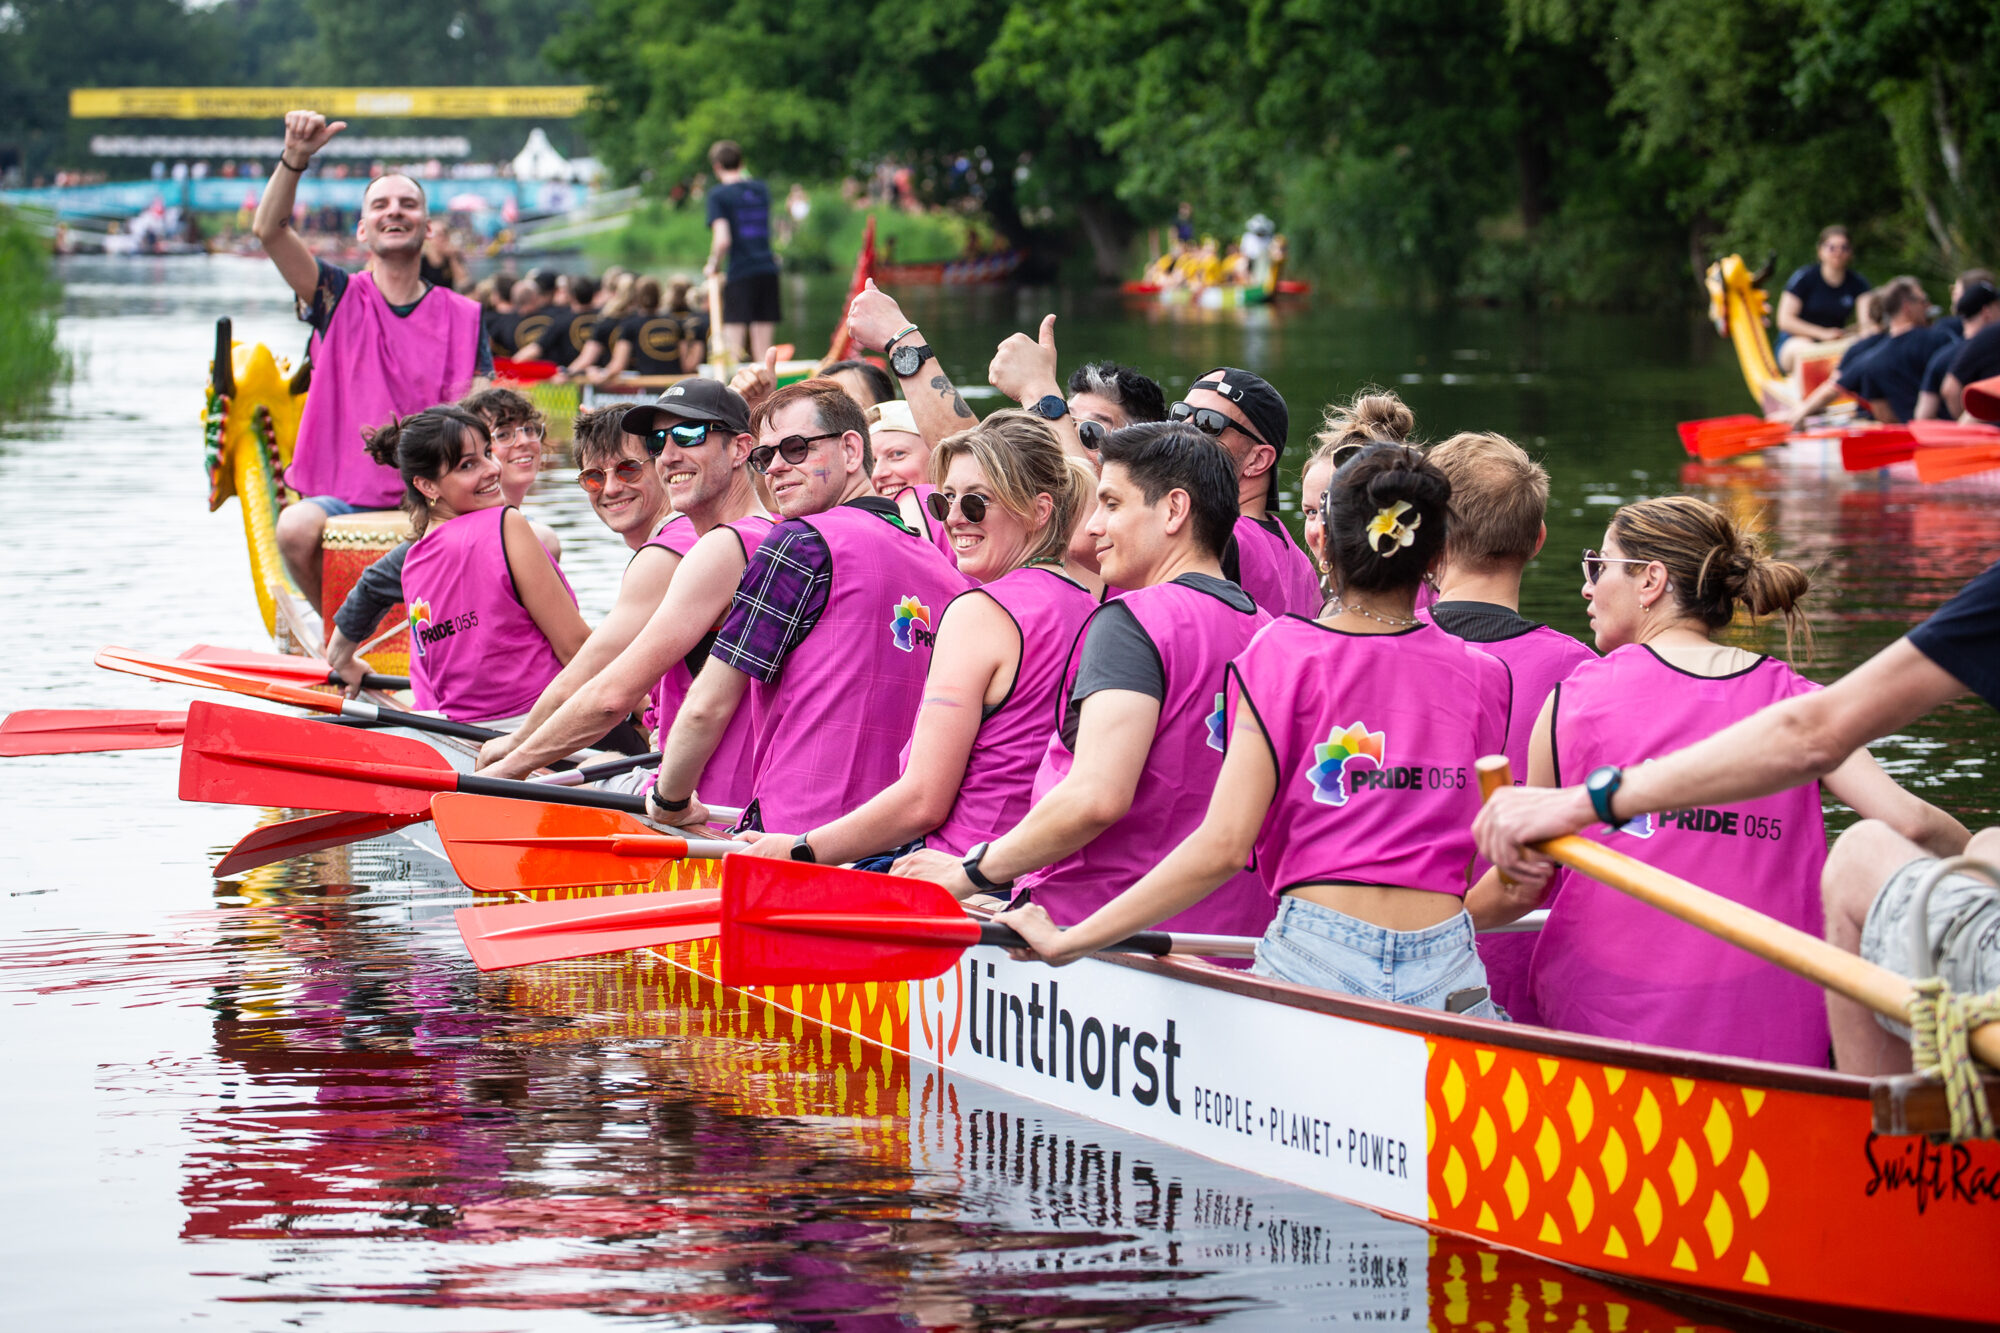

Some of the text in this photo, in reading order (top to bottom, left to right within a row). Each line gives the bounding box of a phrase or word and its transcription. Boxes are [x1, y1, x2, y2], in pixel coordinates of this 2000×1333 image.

[420, 610, 479, 646] PRIDE 055
[1351, 767, 1467, 793] PRIDE 055
[1658, 807, 1782, 841] PRIDE 055
[969, 958, 1181, 1116] linthorst
[1195, 1086, 1408, 1179] PEOPLE PLANET POWER
[1865, 1131, 1947, 1215] Swift
